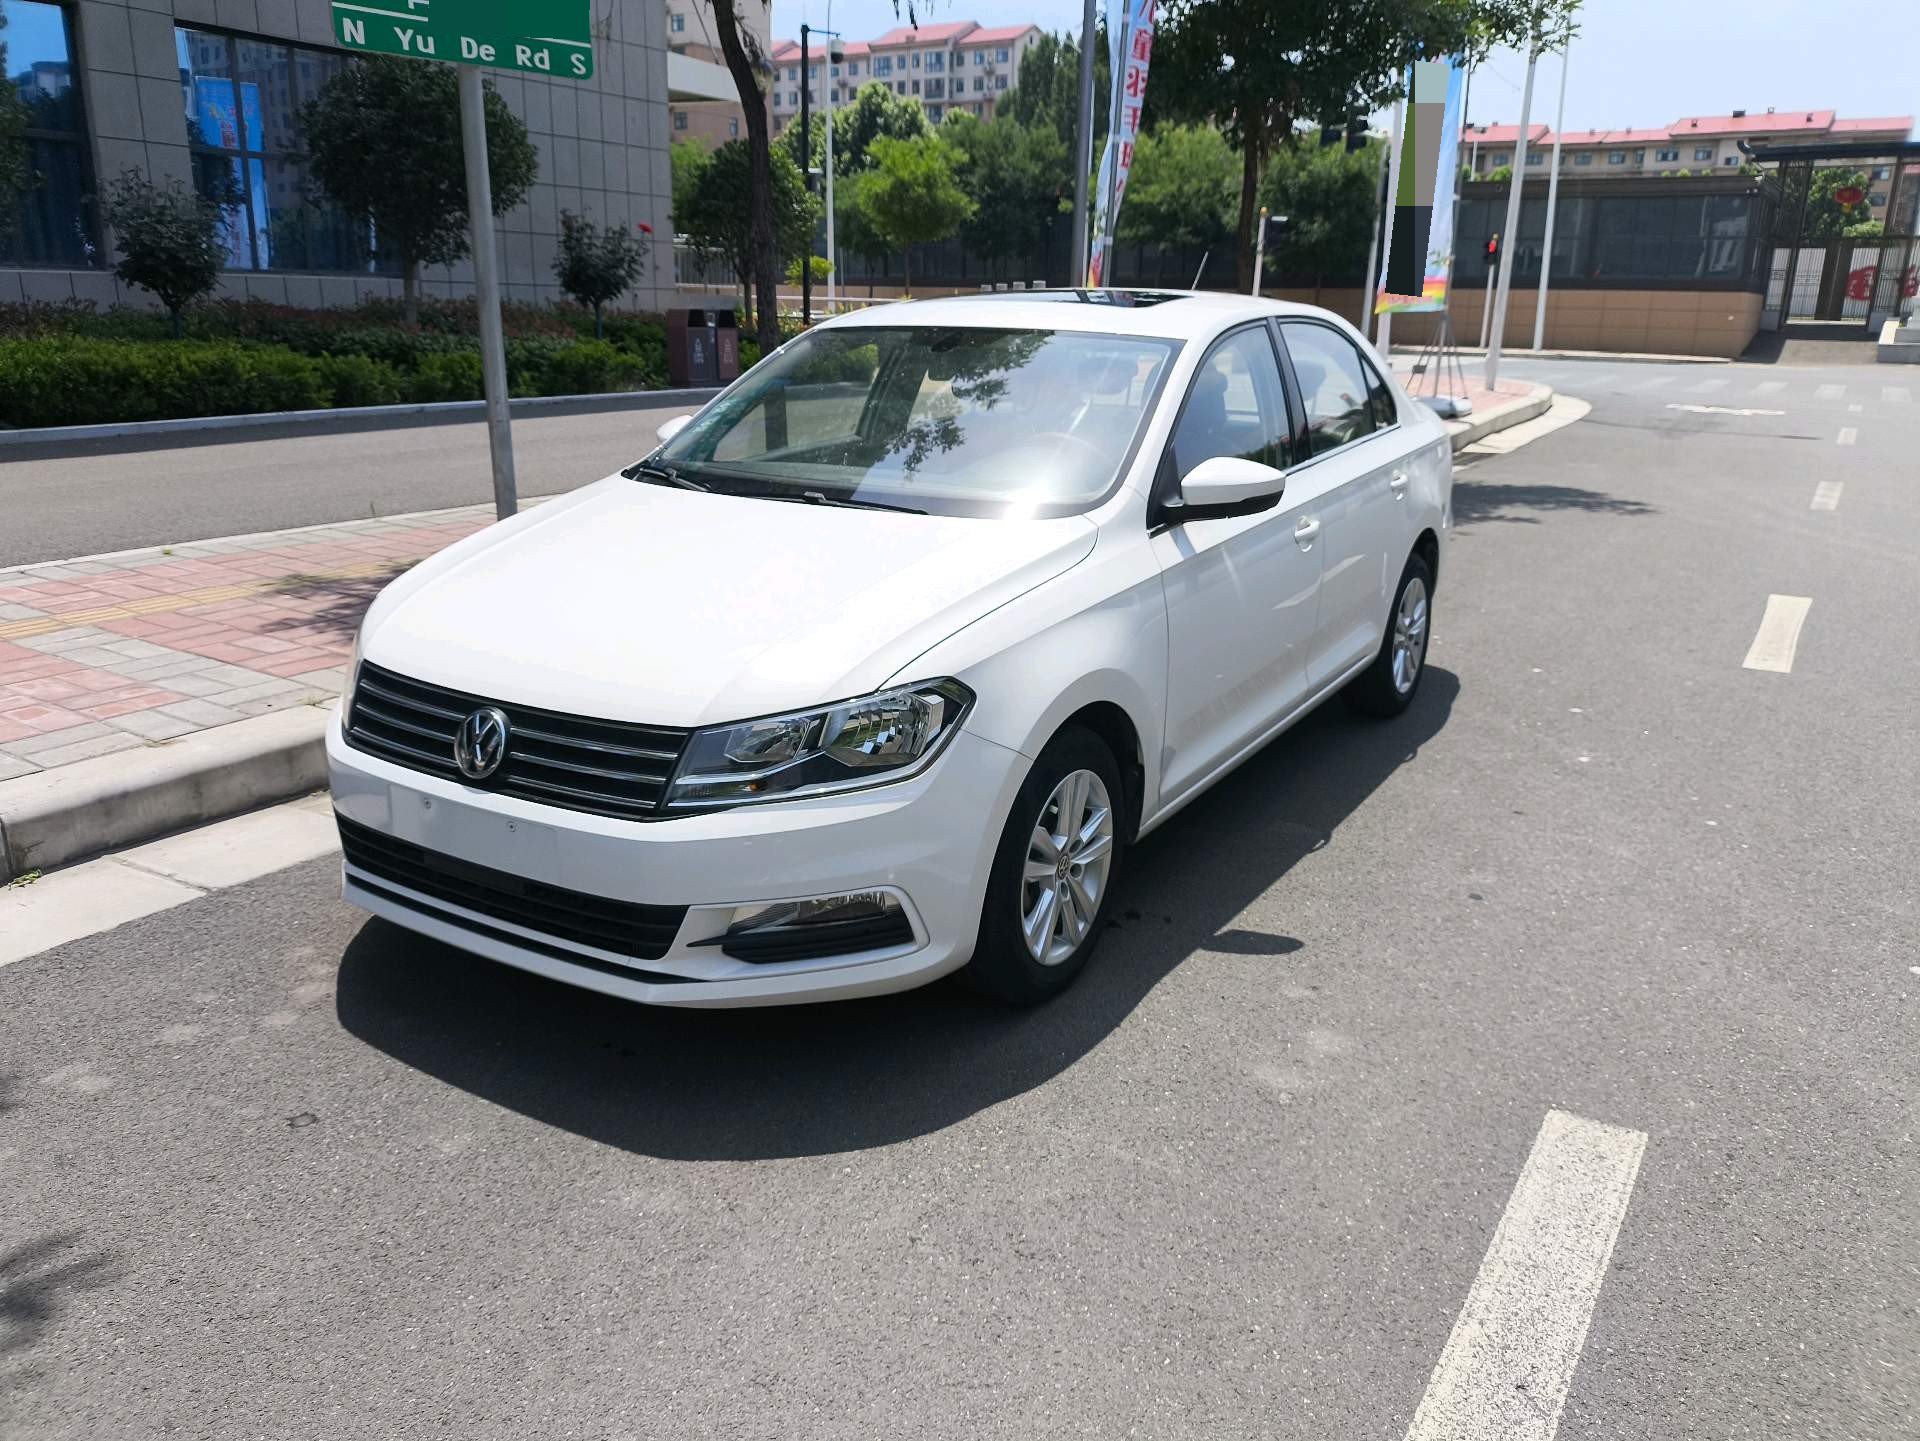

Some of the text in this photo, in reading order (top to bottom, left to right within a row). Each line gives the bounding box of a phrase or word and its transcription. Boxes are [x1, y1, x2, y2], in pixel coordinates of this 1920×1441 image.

[342, 17, 587, 75] N Yu De Rd S
